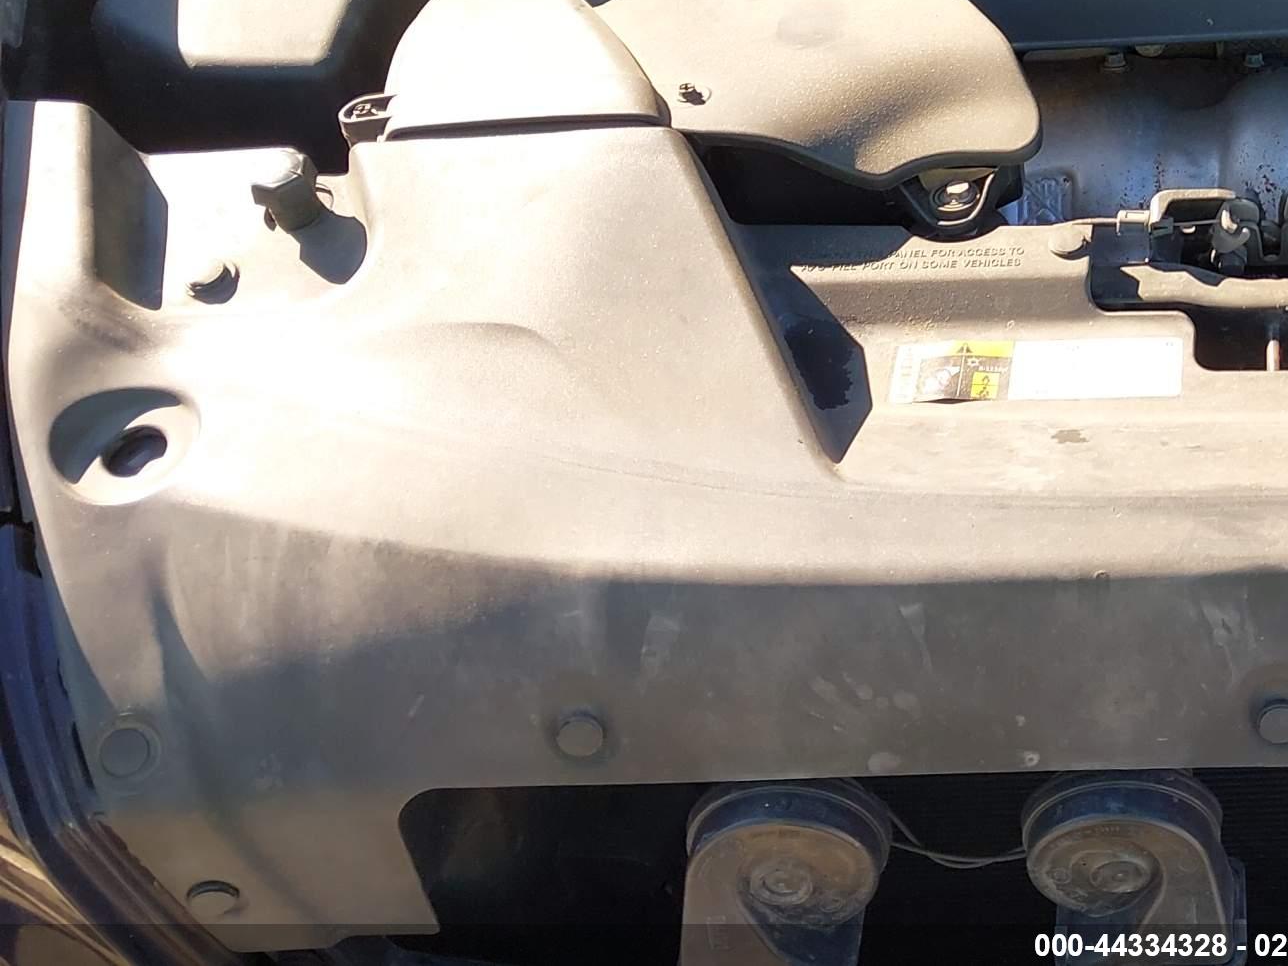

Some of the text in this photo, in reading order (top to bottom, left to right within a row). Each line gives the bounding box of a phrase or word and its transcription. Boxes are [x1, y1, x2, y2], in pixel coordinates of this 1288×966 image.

[930, 249, 957, 258] FOR
[958, 247, 1007, 257] ACCESS
[1009, 247, 1026, 256] TO
[862, 261, 895, 271] PORT
[899, 260, 919, 270] ON
[921, 259, 959, 269] SOME
[963, 258, 1022, 268] VEHICLES
